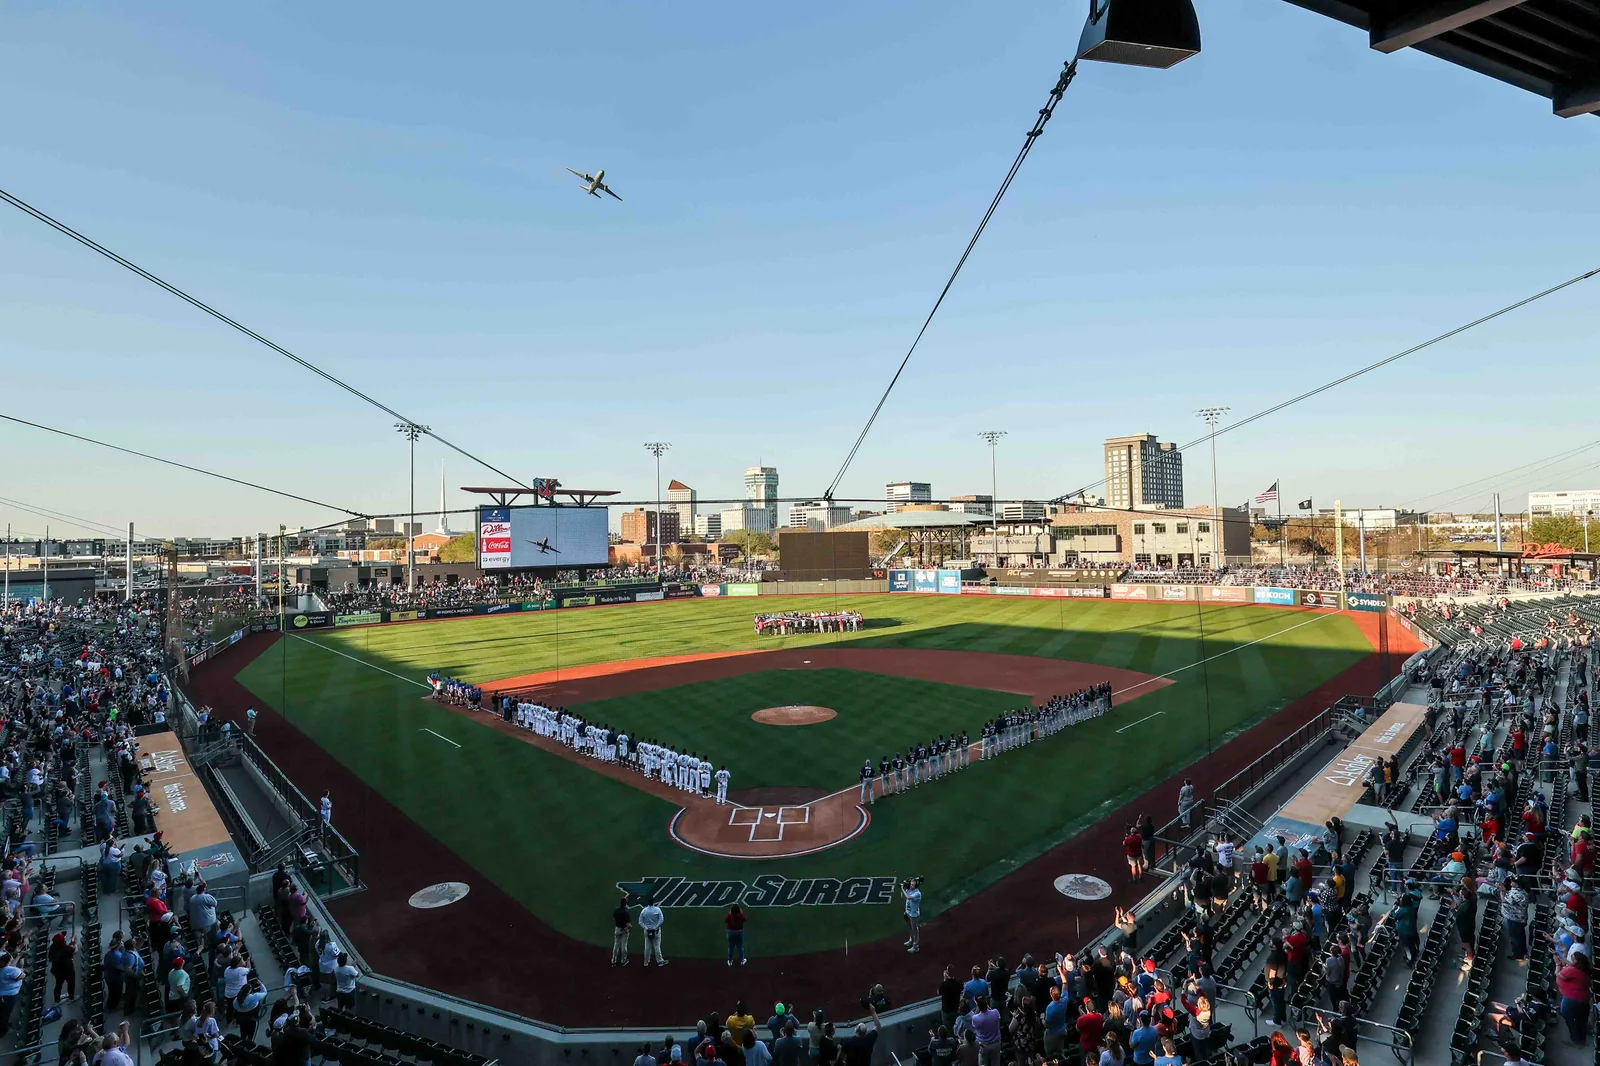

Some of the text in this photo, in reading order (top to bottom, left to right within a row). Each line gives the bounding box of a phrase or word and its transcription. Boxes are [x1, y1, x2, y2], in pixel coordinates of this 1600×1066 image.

[488, 541, 509, 549] Coca-Cola
[1521, 542, 1575, 558] Dillons
[1268, 591, 1291, 600] KOCH
[1359, 599, 1387, 607] SYNDEO
[1332, 754, 1377, 778] Ashley
[743, 875, 896, 907] SURGE
